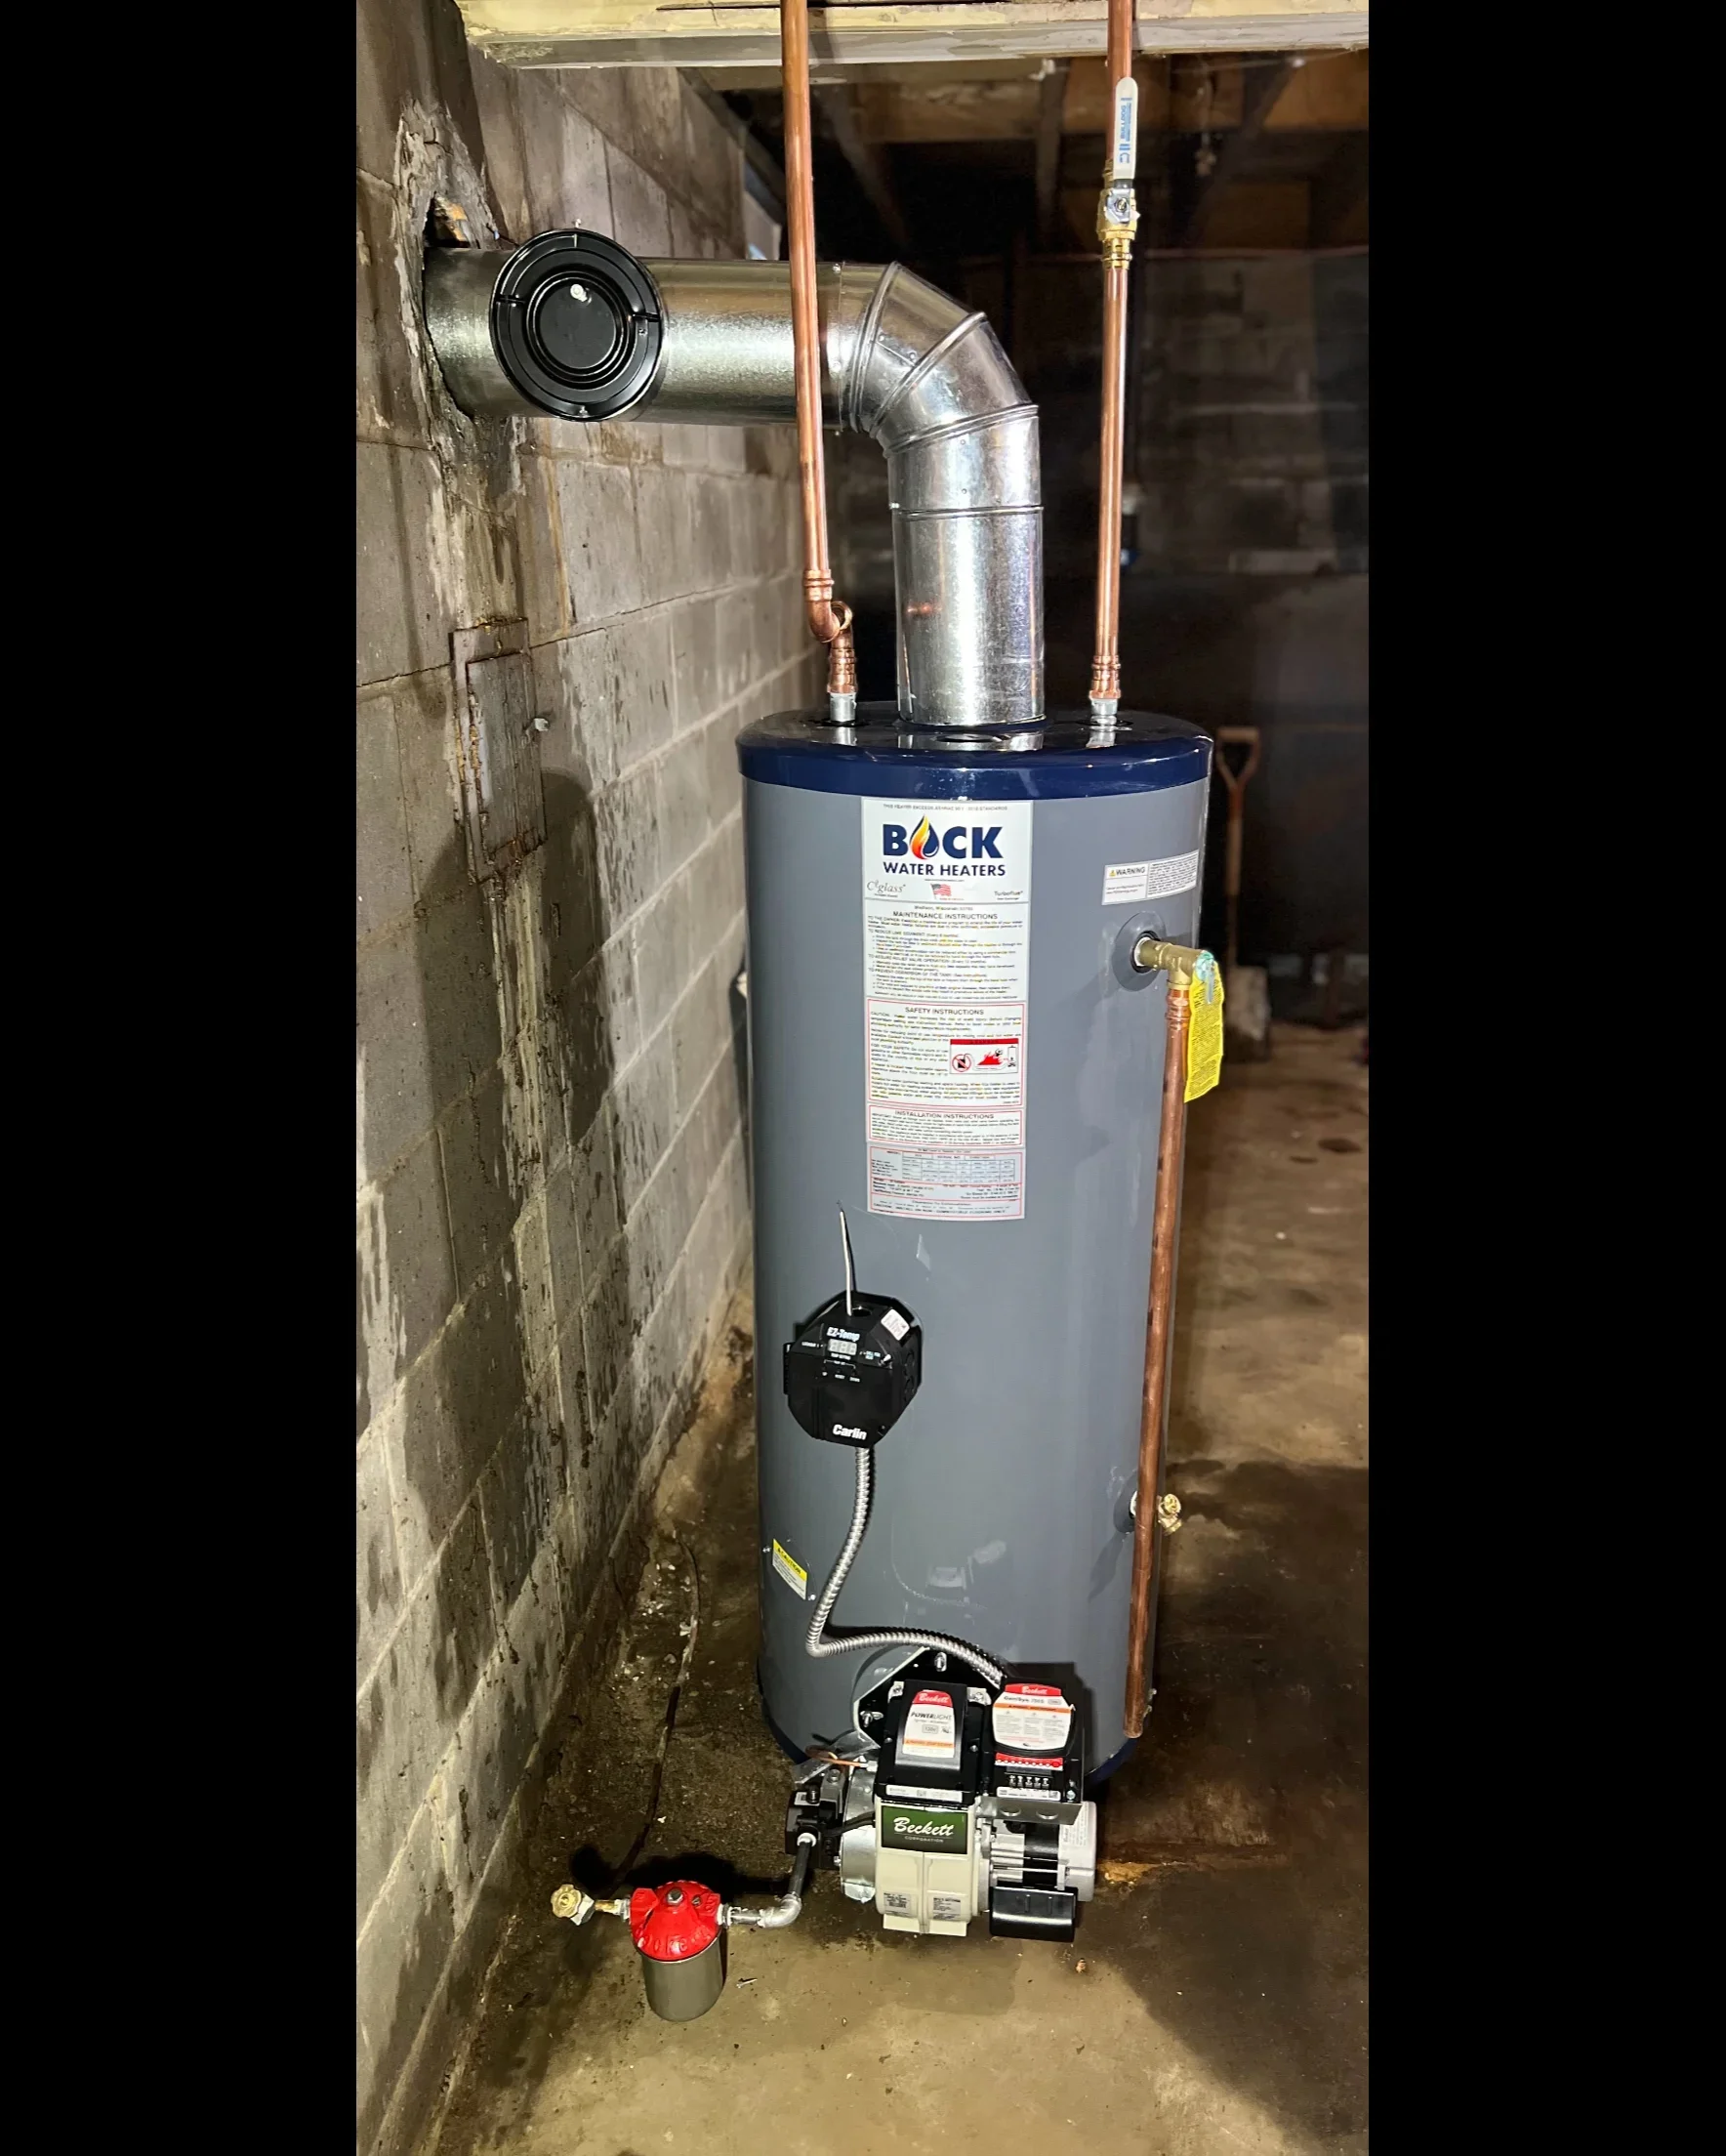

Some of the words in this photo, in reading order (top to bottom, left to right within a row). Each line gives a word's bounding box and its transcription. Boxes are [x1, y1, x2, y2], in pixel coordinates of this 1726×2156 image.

[883, 861, 934, 876] WATER
[940, 864, 1006, 877] HEATERS
[1116, 866, 1145, 875] WARNING
[893, 911, 943, 920] MAINTENANCE
[827, 1326, 860, 1342] EZ-Temp
[833, 1424, 867, 1440] Carlin
[919, 1692, 950, 1703] Beckett
[911, 1712, 952, 1721] POWERLIGHT
[893, 1816, 955, 1837] Beckett
